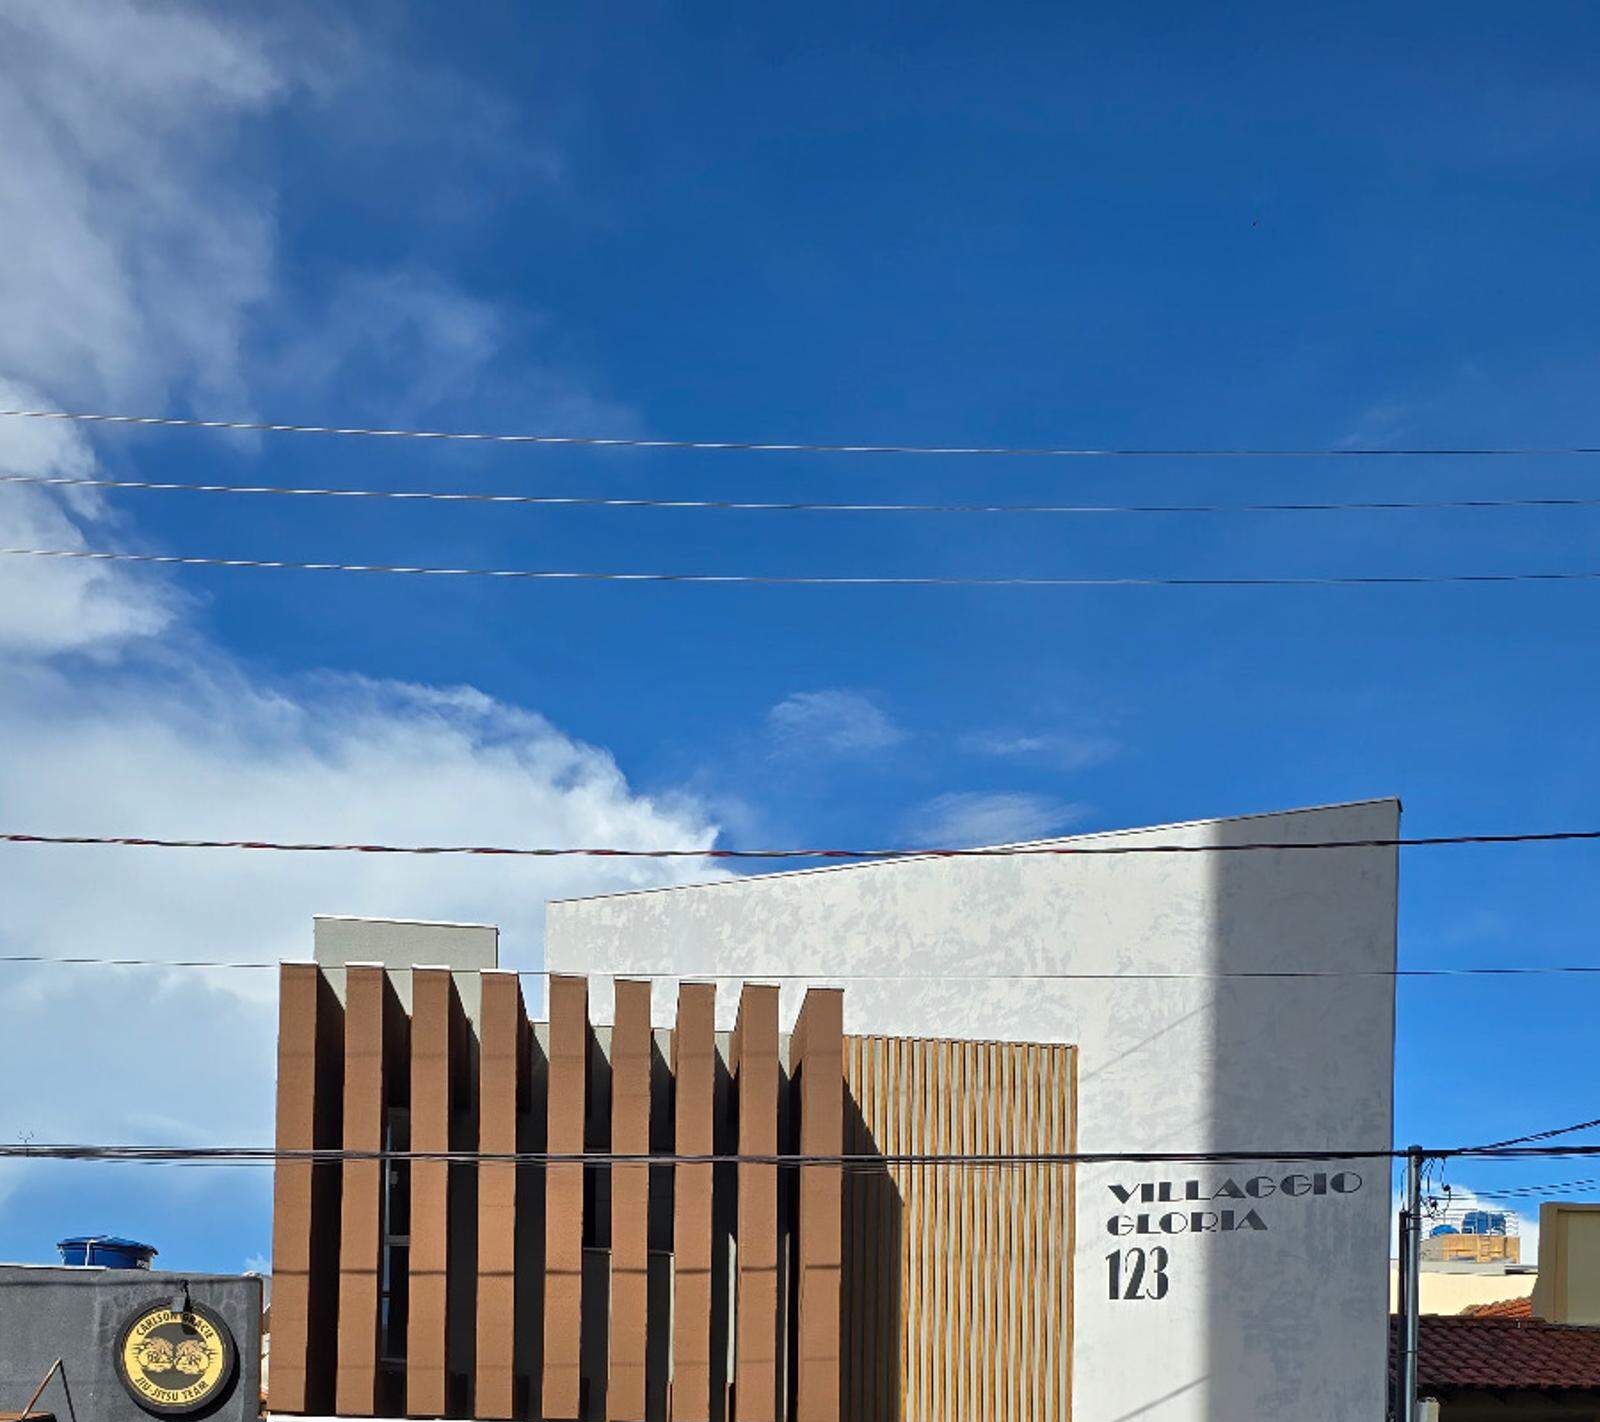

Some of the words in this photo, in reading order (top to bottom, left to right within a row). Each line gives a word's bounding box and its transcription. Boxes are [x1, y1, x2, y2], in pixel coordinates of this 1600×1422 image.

[1107, 1171, 1363, 1204] VILLAGGIO
[1106, 1208, 1268, 1236] GLORIA
[1105, 1245, 1169, 1300] 123
[136, 1312, 178, 1336] CARLSON
[180, 1380, 209, 1400] TEAM
